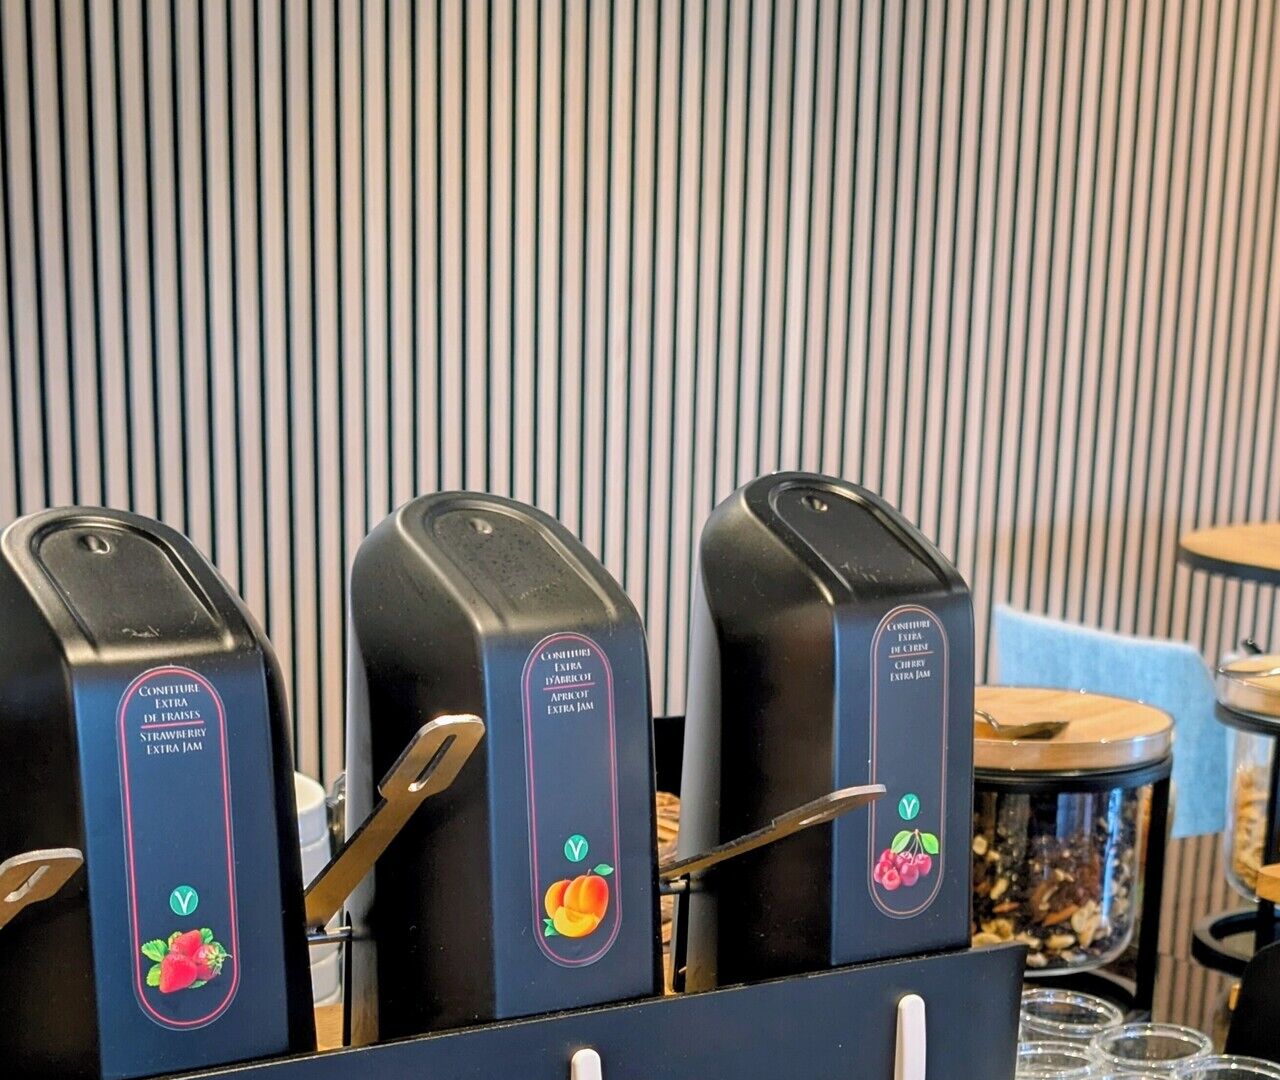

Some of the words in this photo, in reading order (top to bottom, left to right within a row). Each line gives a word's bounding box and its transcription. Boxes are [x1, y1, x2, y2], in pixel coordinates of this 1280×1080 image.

[898, 632, 922, 642] EXTRA
[554, 661, 582, 672] EXTRA
[894, 659, 926, 670] CHERRY
[890, 672, 914, 682] EXTRA
[915, 670, 931, 680] JAM
[138, 684, 200, 697] CONFITURE
[550, 690, 589, 702] APRICOT
[155, 698, 188, 709] EXTRA
[547, 704, 575, 715] EXTRA
[577, 701, 594, 713] JAM
[143, 713, 158, 723] DE
[160, 710, 201, 721] FRAISES
[140, 728, 207, 742] STRAWBERRY
[147, 744, 180, 755] EXTRA
[182, 741, 203, 753] JAM
